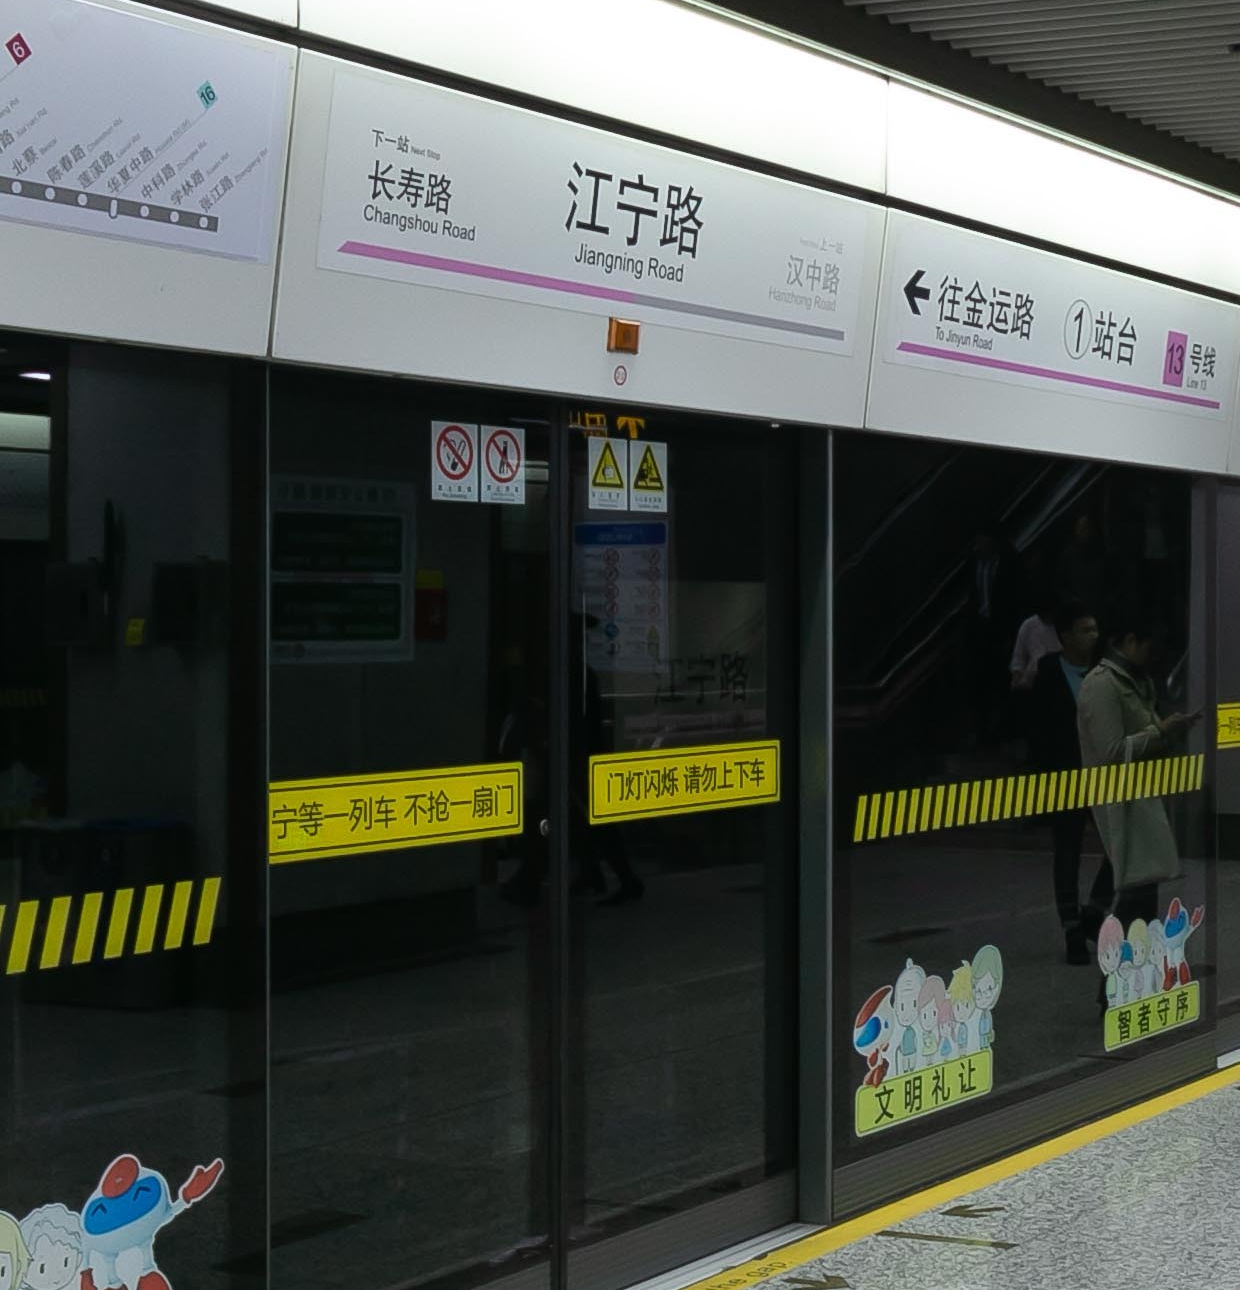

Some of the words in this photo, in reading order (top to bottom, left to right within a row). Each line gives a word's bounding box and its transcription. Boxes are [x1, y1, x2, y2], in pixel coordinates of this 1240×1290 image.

[13, 42, 25, 58] 6
[200, 85, 216, 107] 16
[371, 128, 410, 153] 下一站
[410, 145, 426, 158] Next
[427, 149, 441, 161] Stop
[140, 163, 176, 199] 中科路
[368, 160, 452, 215] 长寿路
[363, 203, 439, 234] Changshou
[442, 219, 477, 242] Road
[565, 161, 704, 259] 江宁路
[574, 242, 644, 280] Jiangning
[647, 255, 685, 284] Road
[786, 254, 840, 296] 汉中路
[768, 286, 813, 311] Hanzhong
[814, 295, 836, 312] Road
[937, 275, 1035, 341] 往金运路
[935, 326, 946, 342] To
[946, 327, 971, 349] Jinyun
[972, 333, 993, 351] Road
[606, 766, 680, 804] 门灯闪烁
[683, 758, 766, 796] 请勿上下车
[271, 797, 397, 840] 宁等一列车
[404, 784, 513, 827] 不抢一扇门
[1116, 992, 1190, 1042] 智者守序
[874, 1062, 977, 1125] 文明礼让
